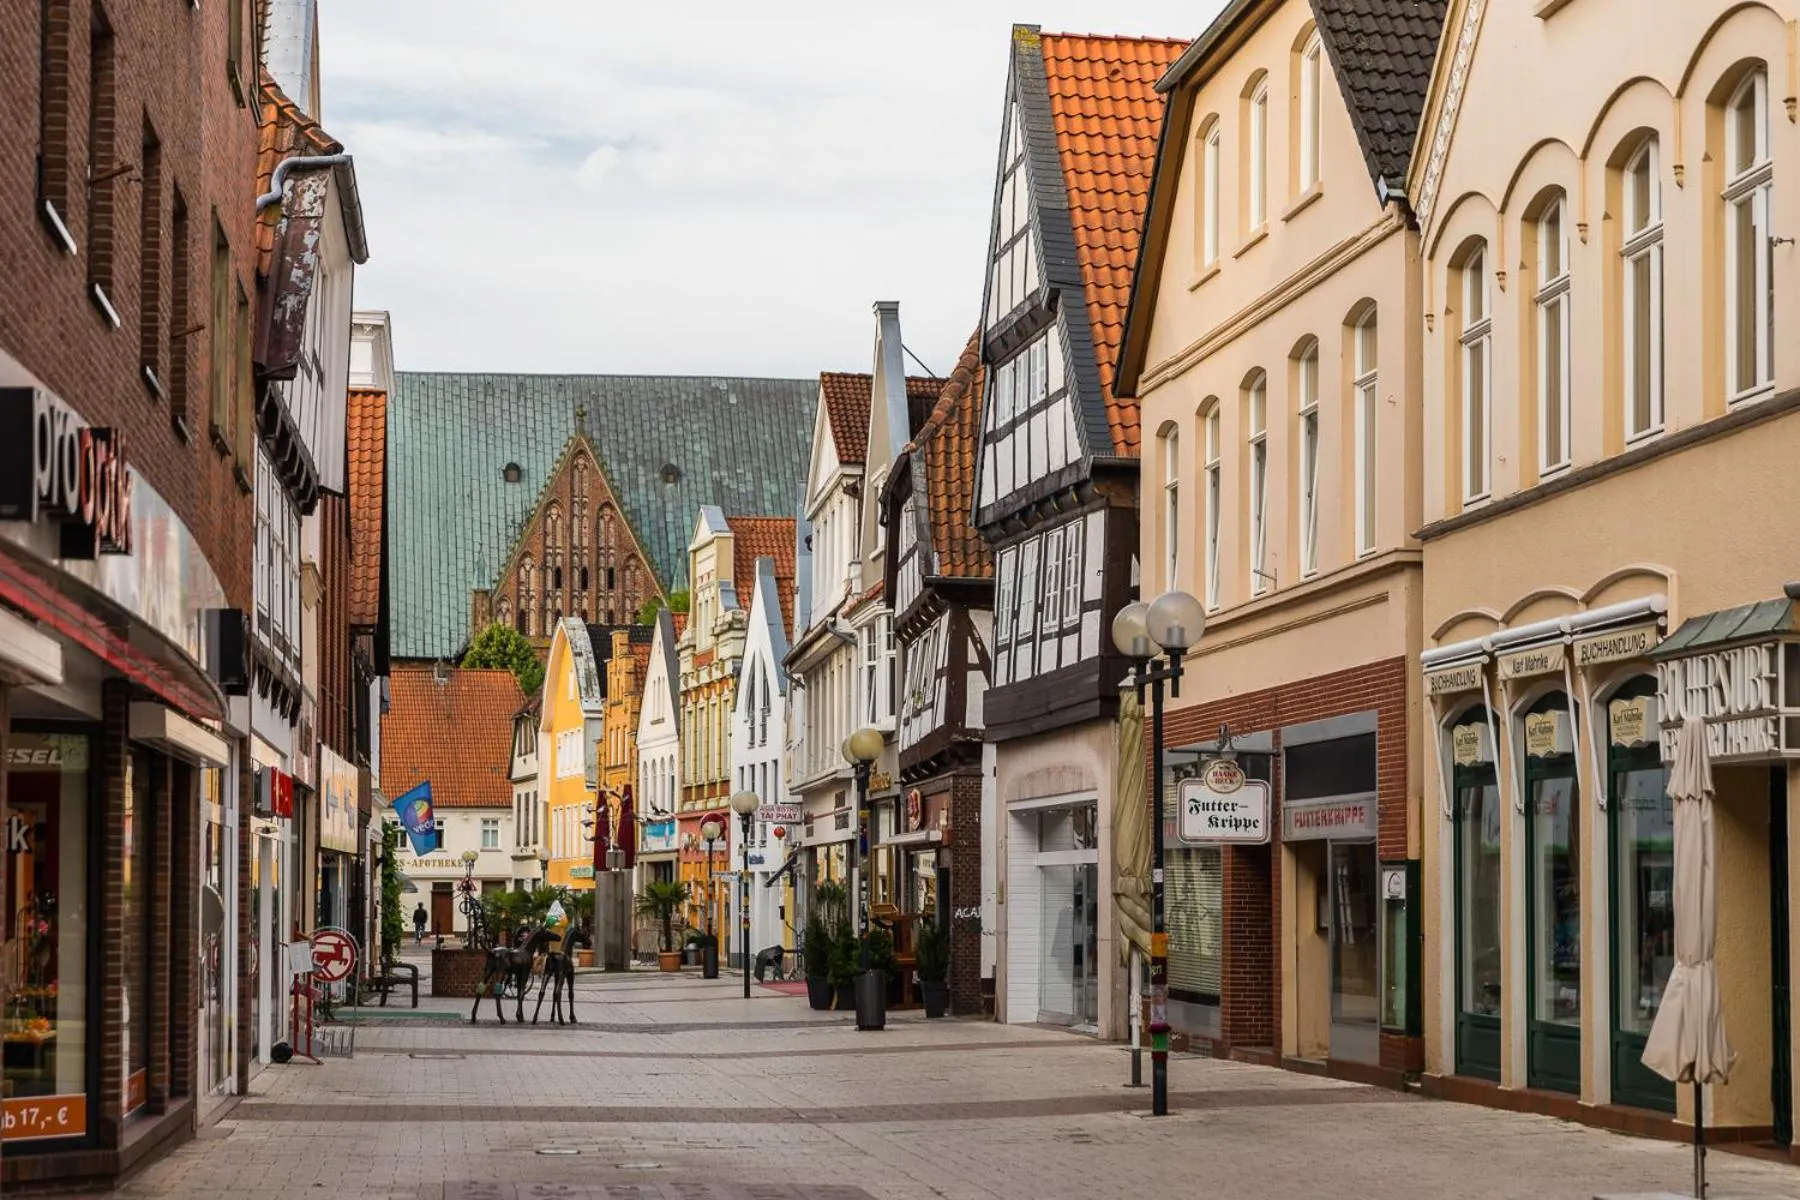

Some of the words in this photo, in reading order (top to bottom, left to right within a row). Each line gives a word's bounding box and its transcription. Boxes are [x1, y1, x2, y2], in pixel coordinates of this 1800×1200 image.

[1581, 633, 1646, 661] BUCHHANDLUNG
[1525, 654, 1549, 671] Mahnke
[1430, 668, 1476, 692] BUCHHANDLUNG
[1208, 815, 1259, 832] Krippe
[1294, 805, 1365, 829] FUTTERKRIPPE
[20, 1108, 52, 1130] 17,-
[57, 1106, 68, 1125] €
